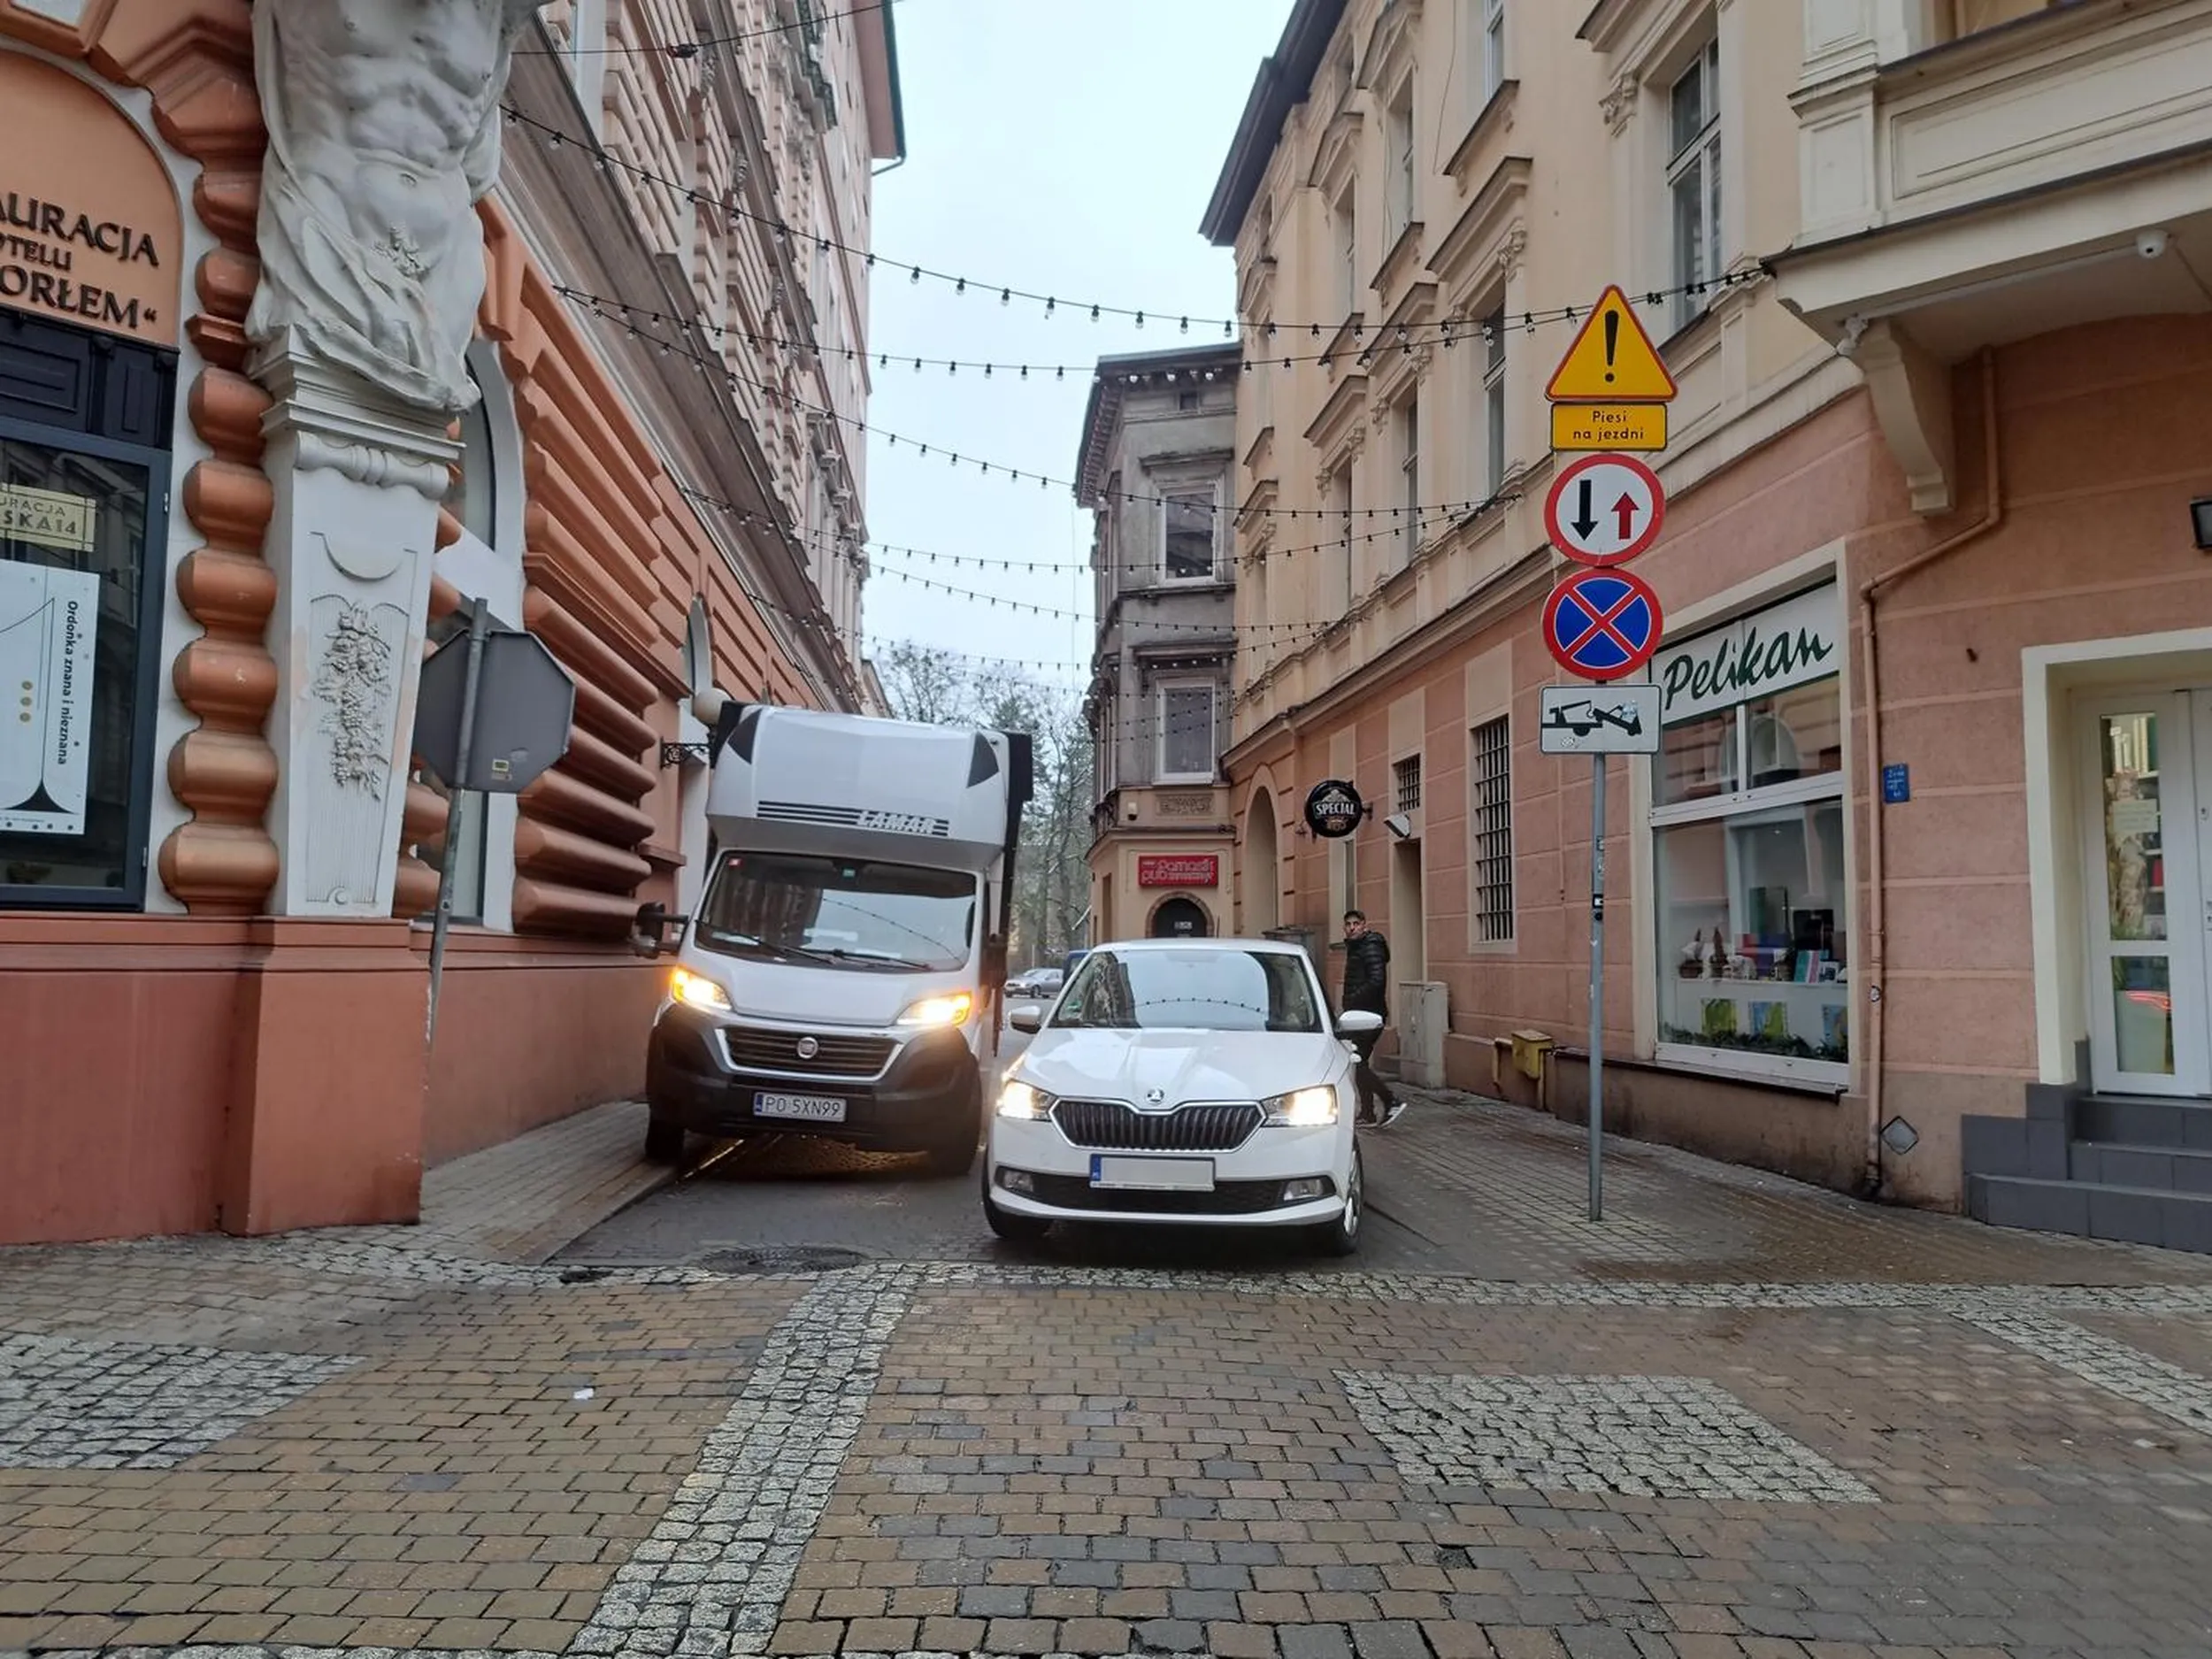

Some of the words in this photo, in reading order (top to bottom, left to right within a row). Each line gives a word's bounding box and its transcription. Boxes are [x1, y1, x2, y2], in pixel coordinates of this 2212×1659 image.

[0, 191, 159, 268] URACJA
[1573, 430, 1591, 439] na
[1597, 426, 1644, 442] jezdni
[1592, 410, 1627, 423] Piesi
[65, 601, 79, 655] Ordonka
[63, 658, 73, 696] znana
[1663, 626, 1833, 710] Pelikan
[58, 707, 73, 764] nieznana
[1316, 803, 1354, 815] SPECIAL
[792, 1098, 841, 1117] 5XN99
